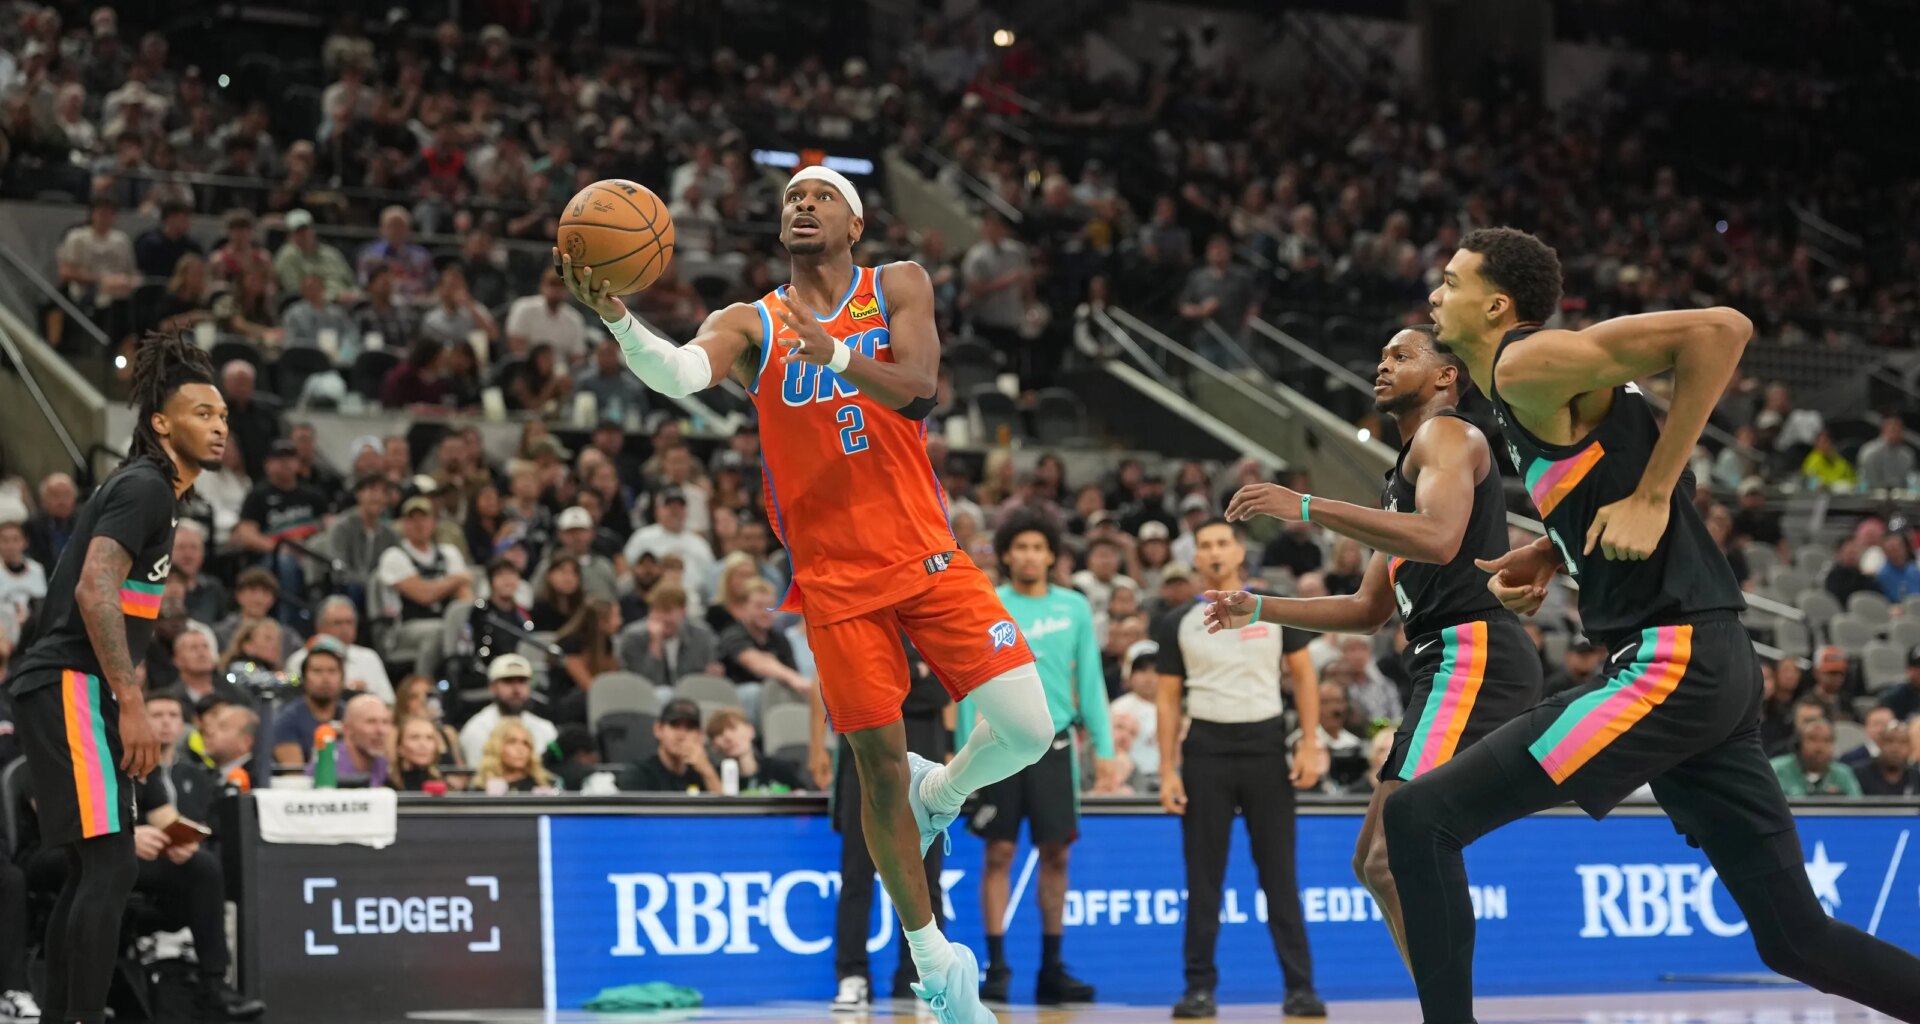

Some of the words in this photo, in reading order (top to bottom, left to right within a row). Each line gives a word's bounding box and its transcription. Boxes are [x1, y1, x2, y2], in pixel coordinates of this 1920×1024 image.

[836, 404, 869, 455] 2
[284, 801, 371, 816] GATORADE
[331, 896, 474, 934] LEDGER
[1061, 888, 1249, 926] OFFICL
[1574, 863, 1748, 938] RBFC
